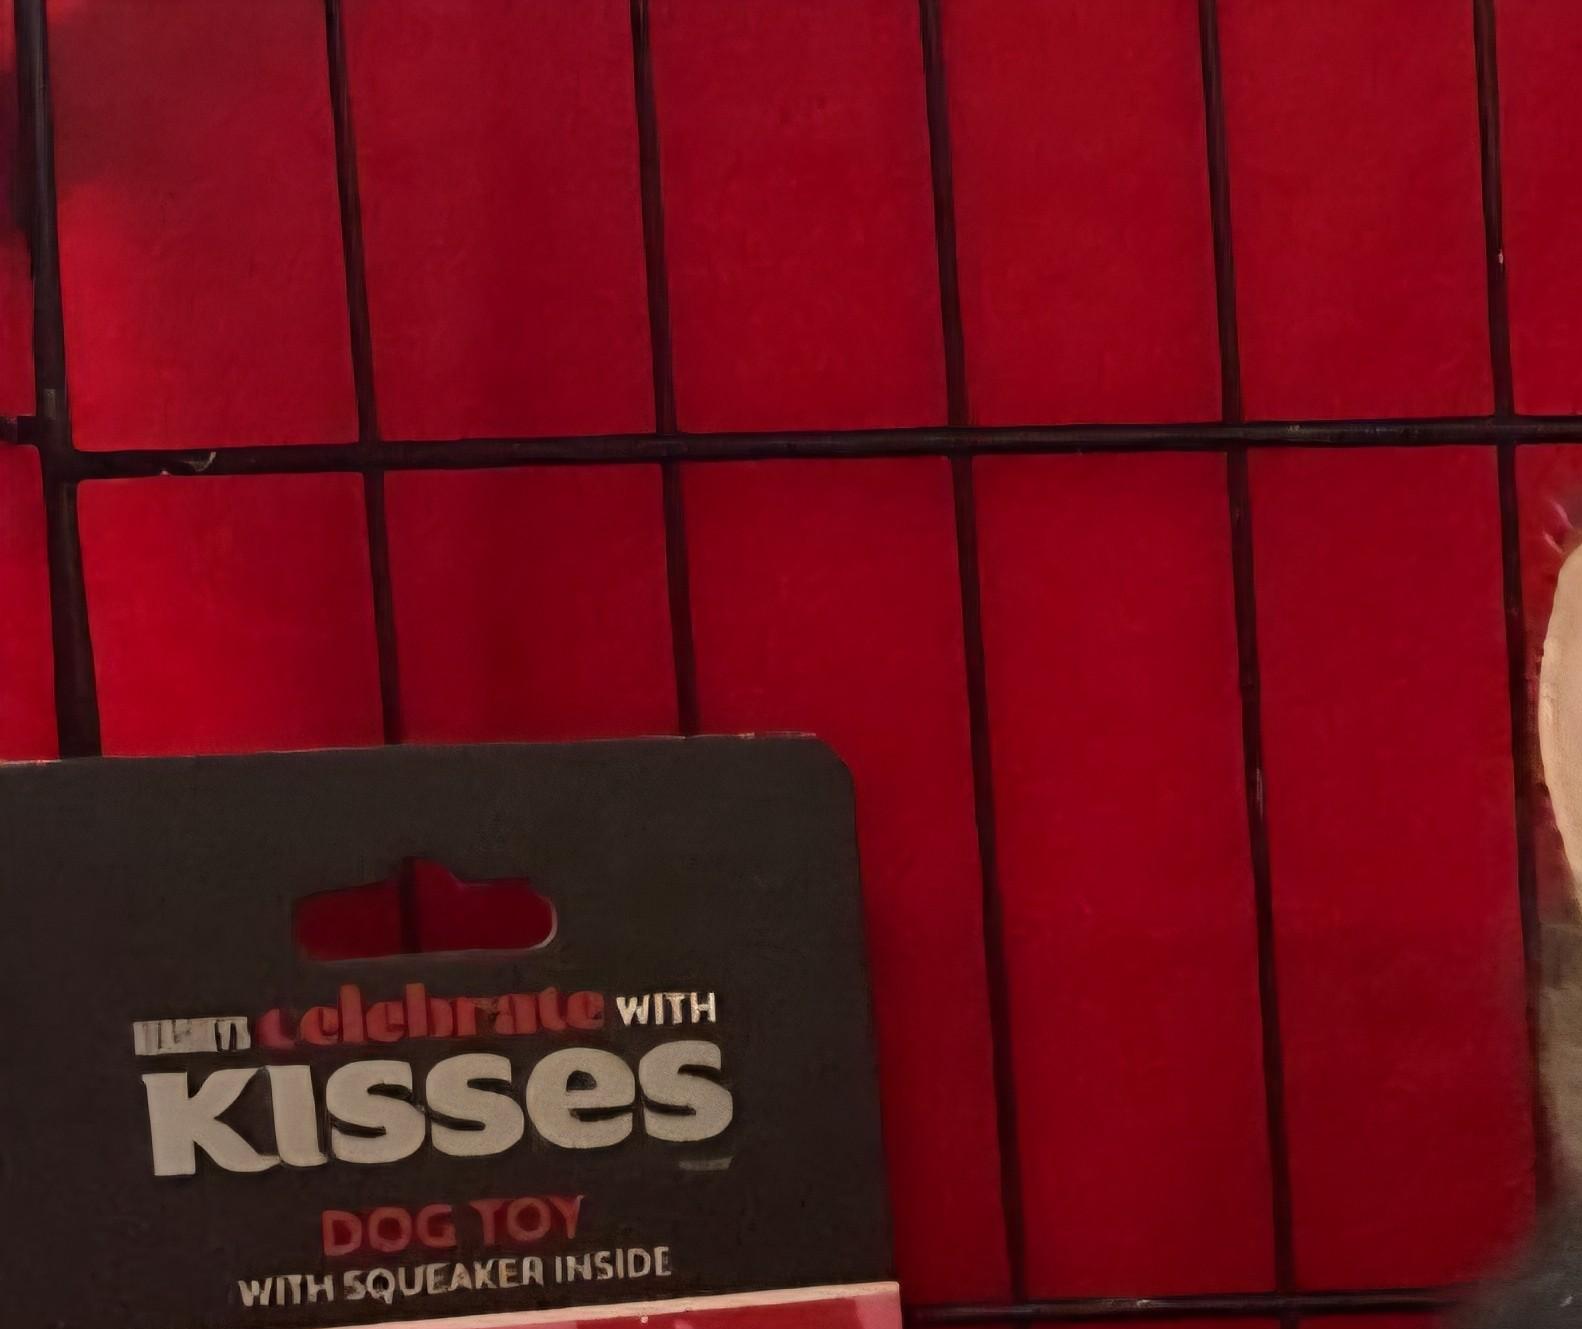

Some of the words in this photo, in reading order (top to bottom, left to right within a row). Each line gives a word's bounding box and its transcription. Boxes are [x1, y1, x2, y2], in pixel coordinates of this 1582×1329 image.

[255, 982, 605, 1049] celebrate
[616, 991, 717, 1026] WITH
[321, 1203, 458, 1257] DOG
[468, 1195, 585, 1246] TOY
[238, 1273, 334, 1307] WITH
[343, 1256, 545, 1304] SQUEAKER
[554, 1246, 672, 1283] INSIDE
